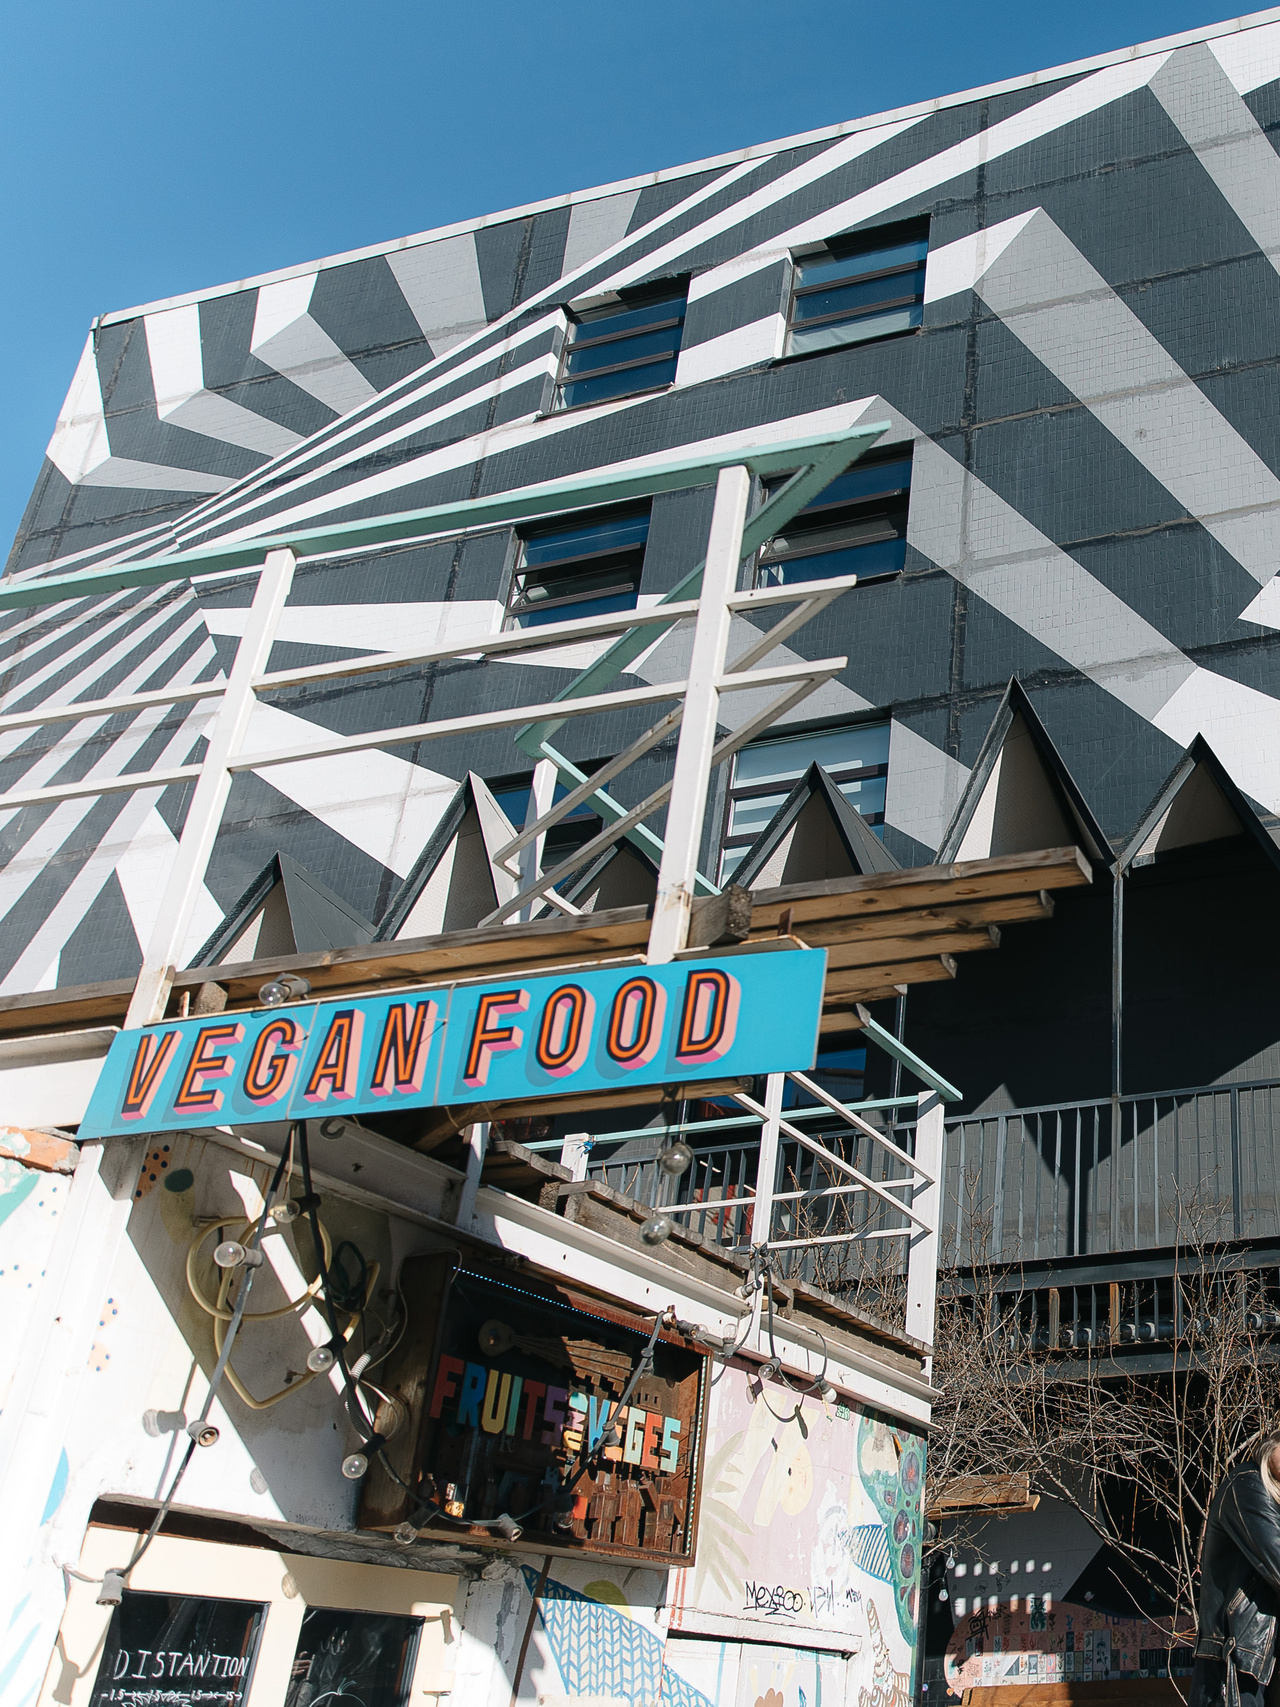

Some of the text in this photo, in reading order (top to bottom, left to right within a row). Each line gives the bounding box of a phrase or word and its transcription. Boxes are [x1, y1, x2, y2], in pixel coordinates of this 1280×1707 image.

[120, 968, 741, 1121] VEGAN FOOD
[429, 1353, 568, 1448] FRUITS
[113, 1649, 250, 1680] DISTANTION
